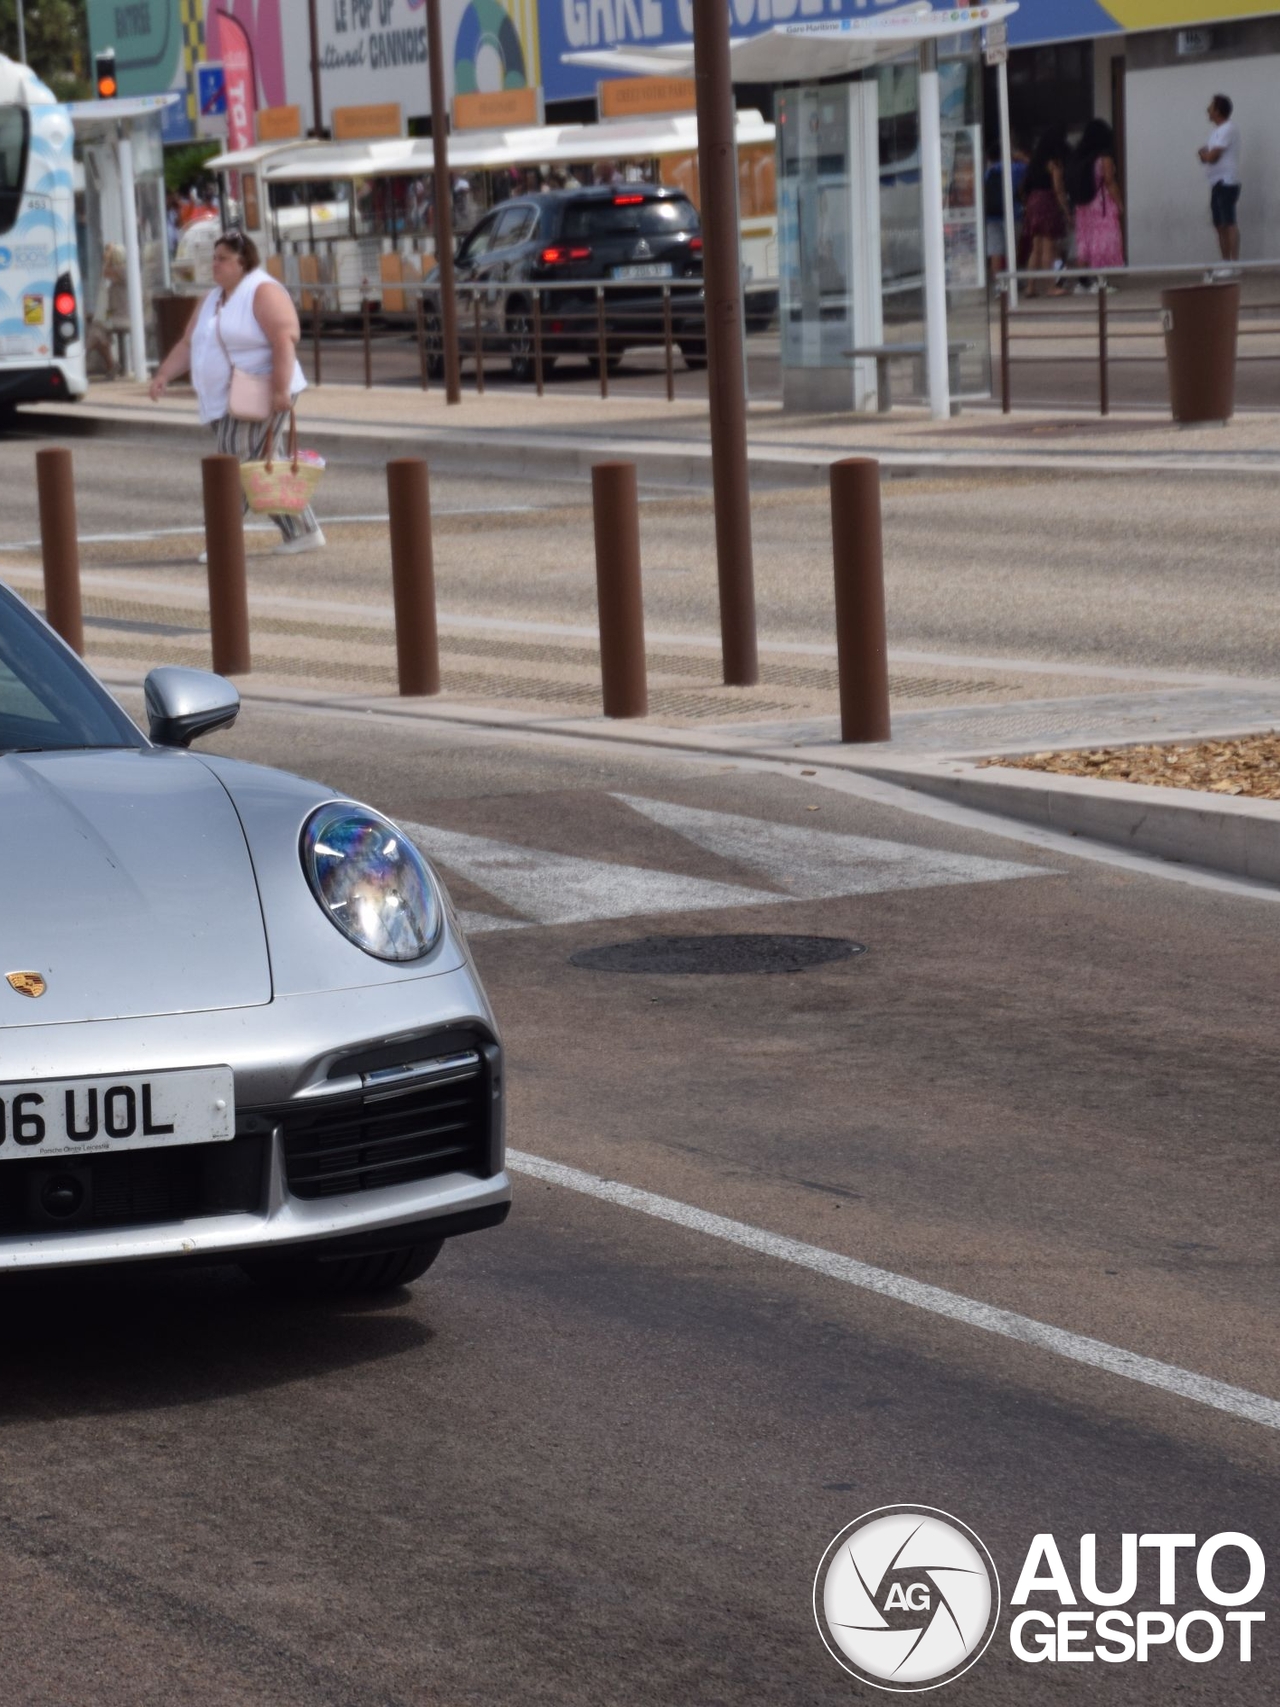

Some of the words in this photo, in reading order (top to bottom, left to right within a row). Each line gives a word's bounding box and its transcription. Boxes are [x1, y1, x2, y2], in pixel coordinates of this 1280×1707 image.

[310, 39, 365, 70] ulturel
[369, 27, 428, 69] CANNOIS
[65, 1083, 174, 1142] UOL
